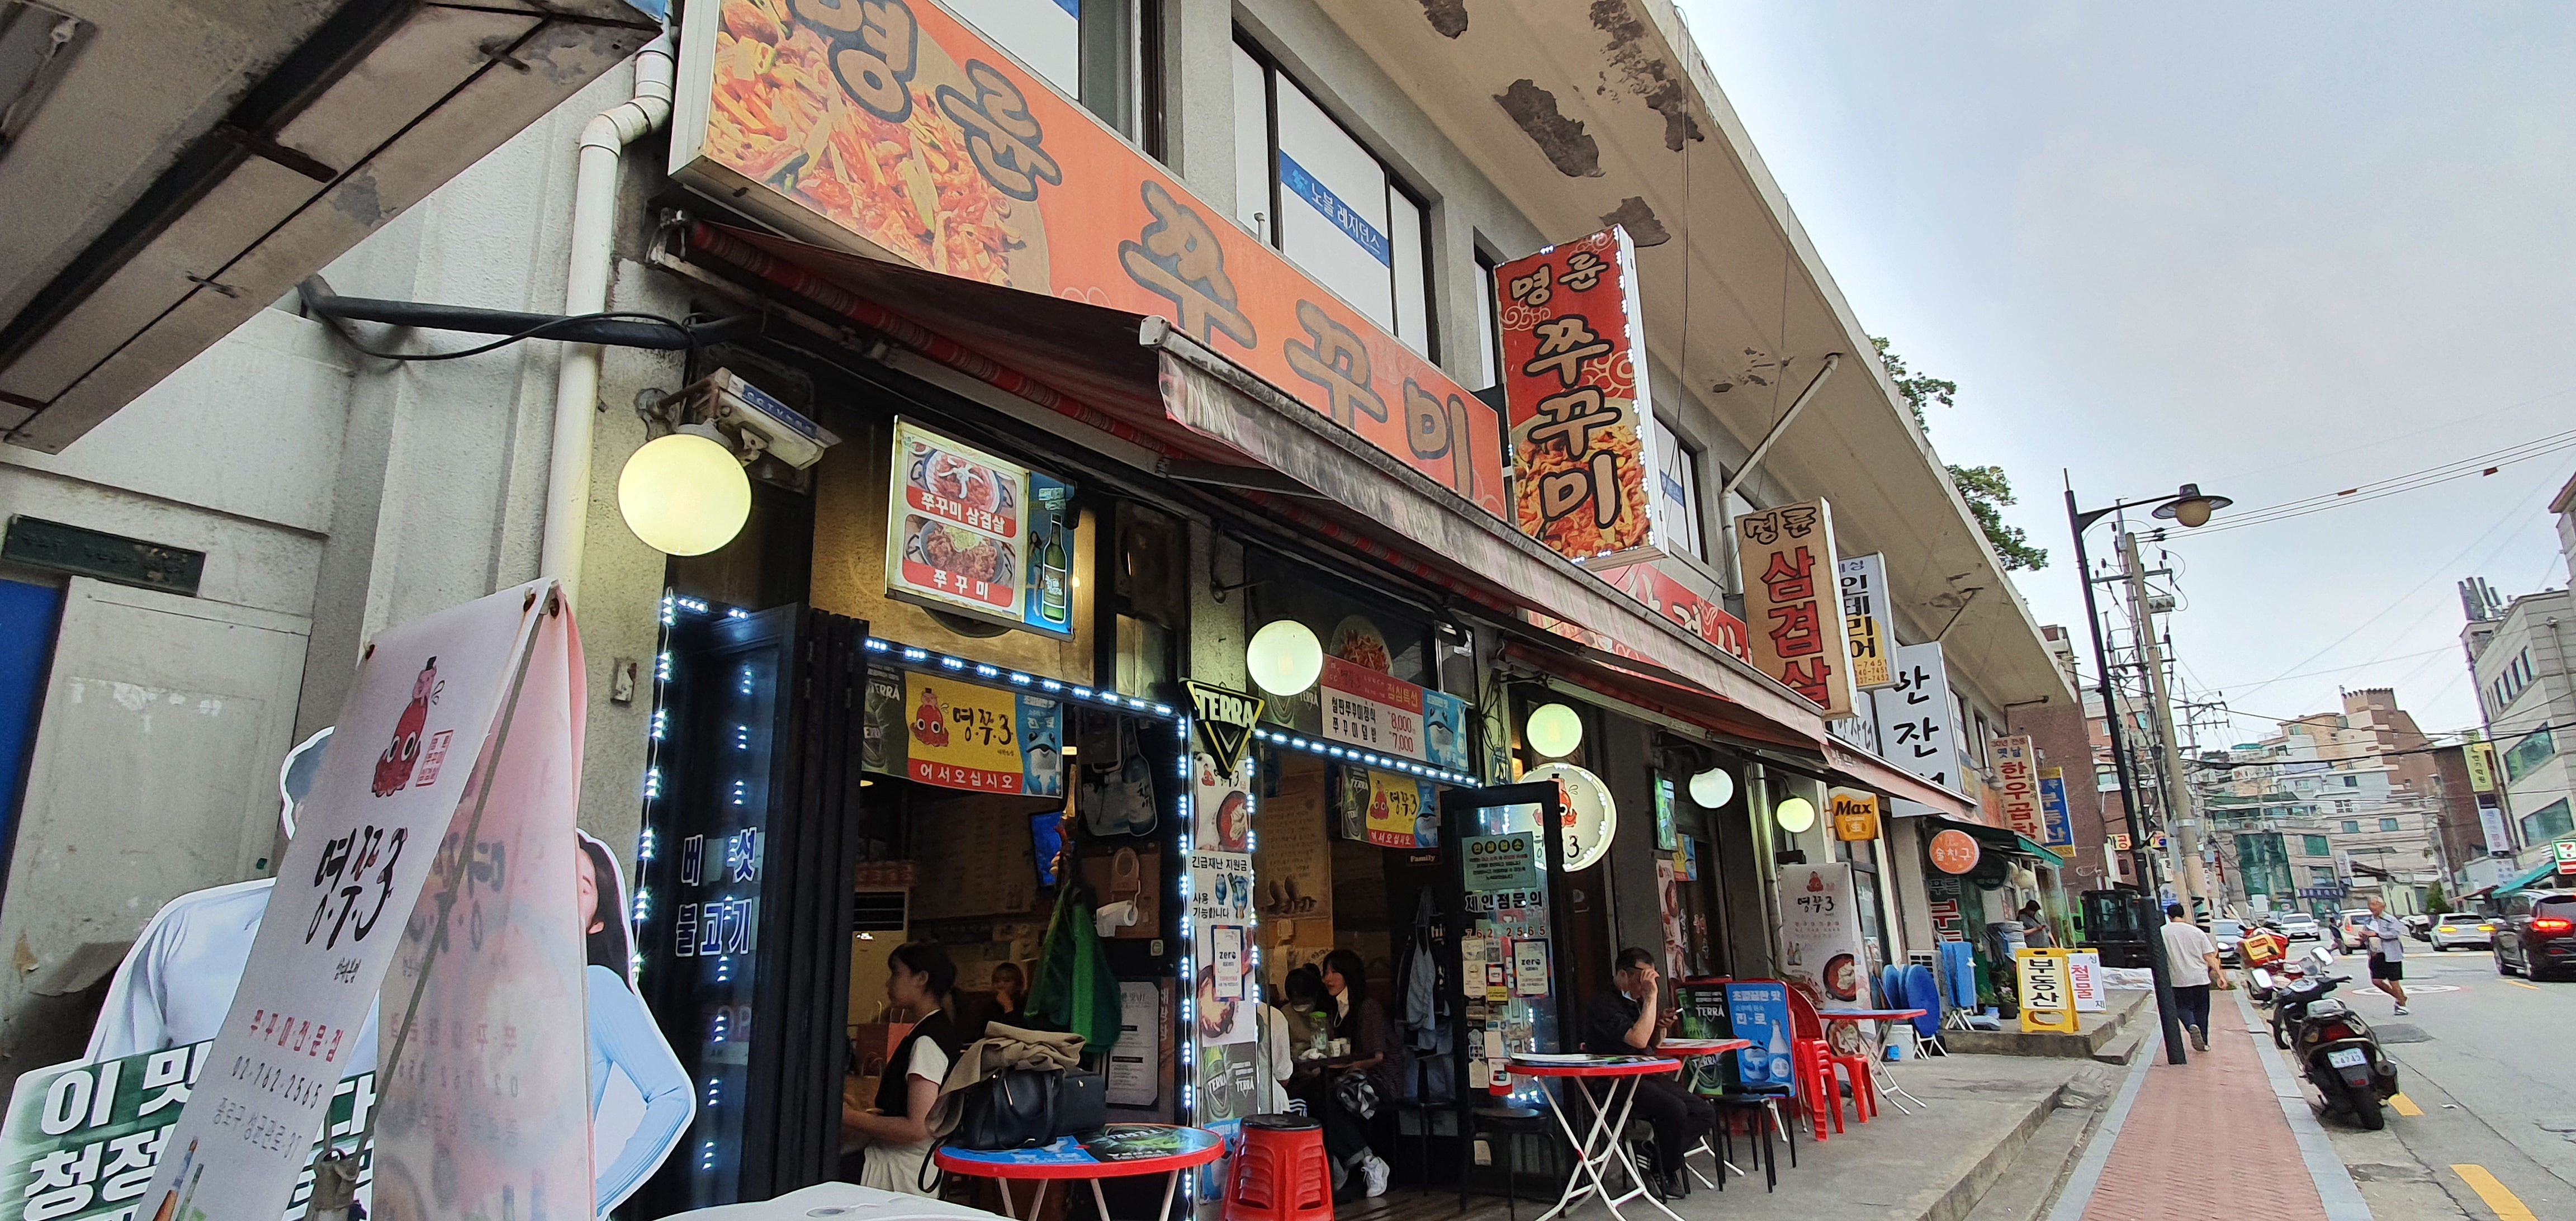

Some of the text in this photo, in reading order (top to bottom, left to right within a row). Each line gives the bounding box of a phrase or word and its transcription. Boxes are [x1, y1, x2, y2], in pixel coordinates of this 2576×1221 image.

[1311, 182, 1381, 255] 노블 레지던스
[1511, 250, 1609, 307] 명륜
[1117, 178, 1471, 501] 쭈꾸미
[746, 391, 784, 416] CCTV
[1522, 313, 1622, 530] 쭈꾸미
[921, 491, 1006, 534] 쭈꾸미 삼겹살
[932, 568, 989, 602] 쭈꾸미
[1760, 545, 1831, 710] 삼겹살
[1840, 574, 1876, 659] 인테리어
[1195, 688, 1256, 732] TERRA
[1391, 712, 1413, 733] 8,000
[1393, 732, 1414, 753] 7,000
[920, 763, 1014, 789] 어서오십시오
[1835, 800, 1872, 816] Max
[2000, 760, 2038, 840] 한우곱창
[1192, 856, 1247, 872] 긴급재난 지원금
[1193, 892, 1208, 904] 사용
[1465, 891, 1543, 912] 체인점문의
[675, 898, 752, 957] 불고기
[1465, 925, 1546, 940] 762 2565
[2028, 959, 2060, 1008] 부동산
[2071, 964, 2094, 1000] 철물
[1696, 1005, 1725, 1018] TERRA
[41, 1061, 123, 1136] 이
[1236, 1076, 1255, 1092] TERRA
